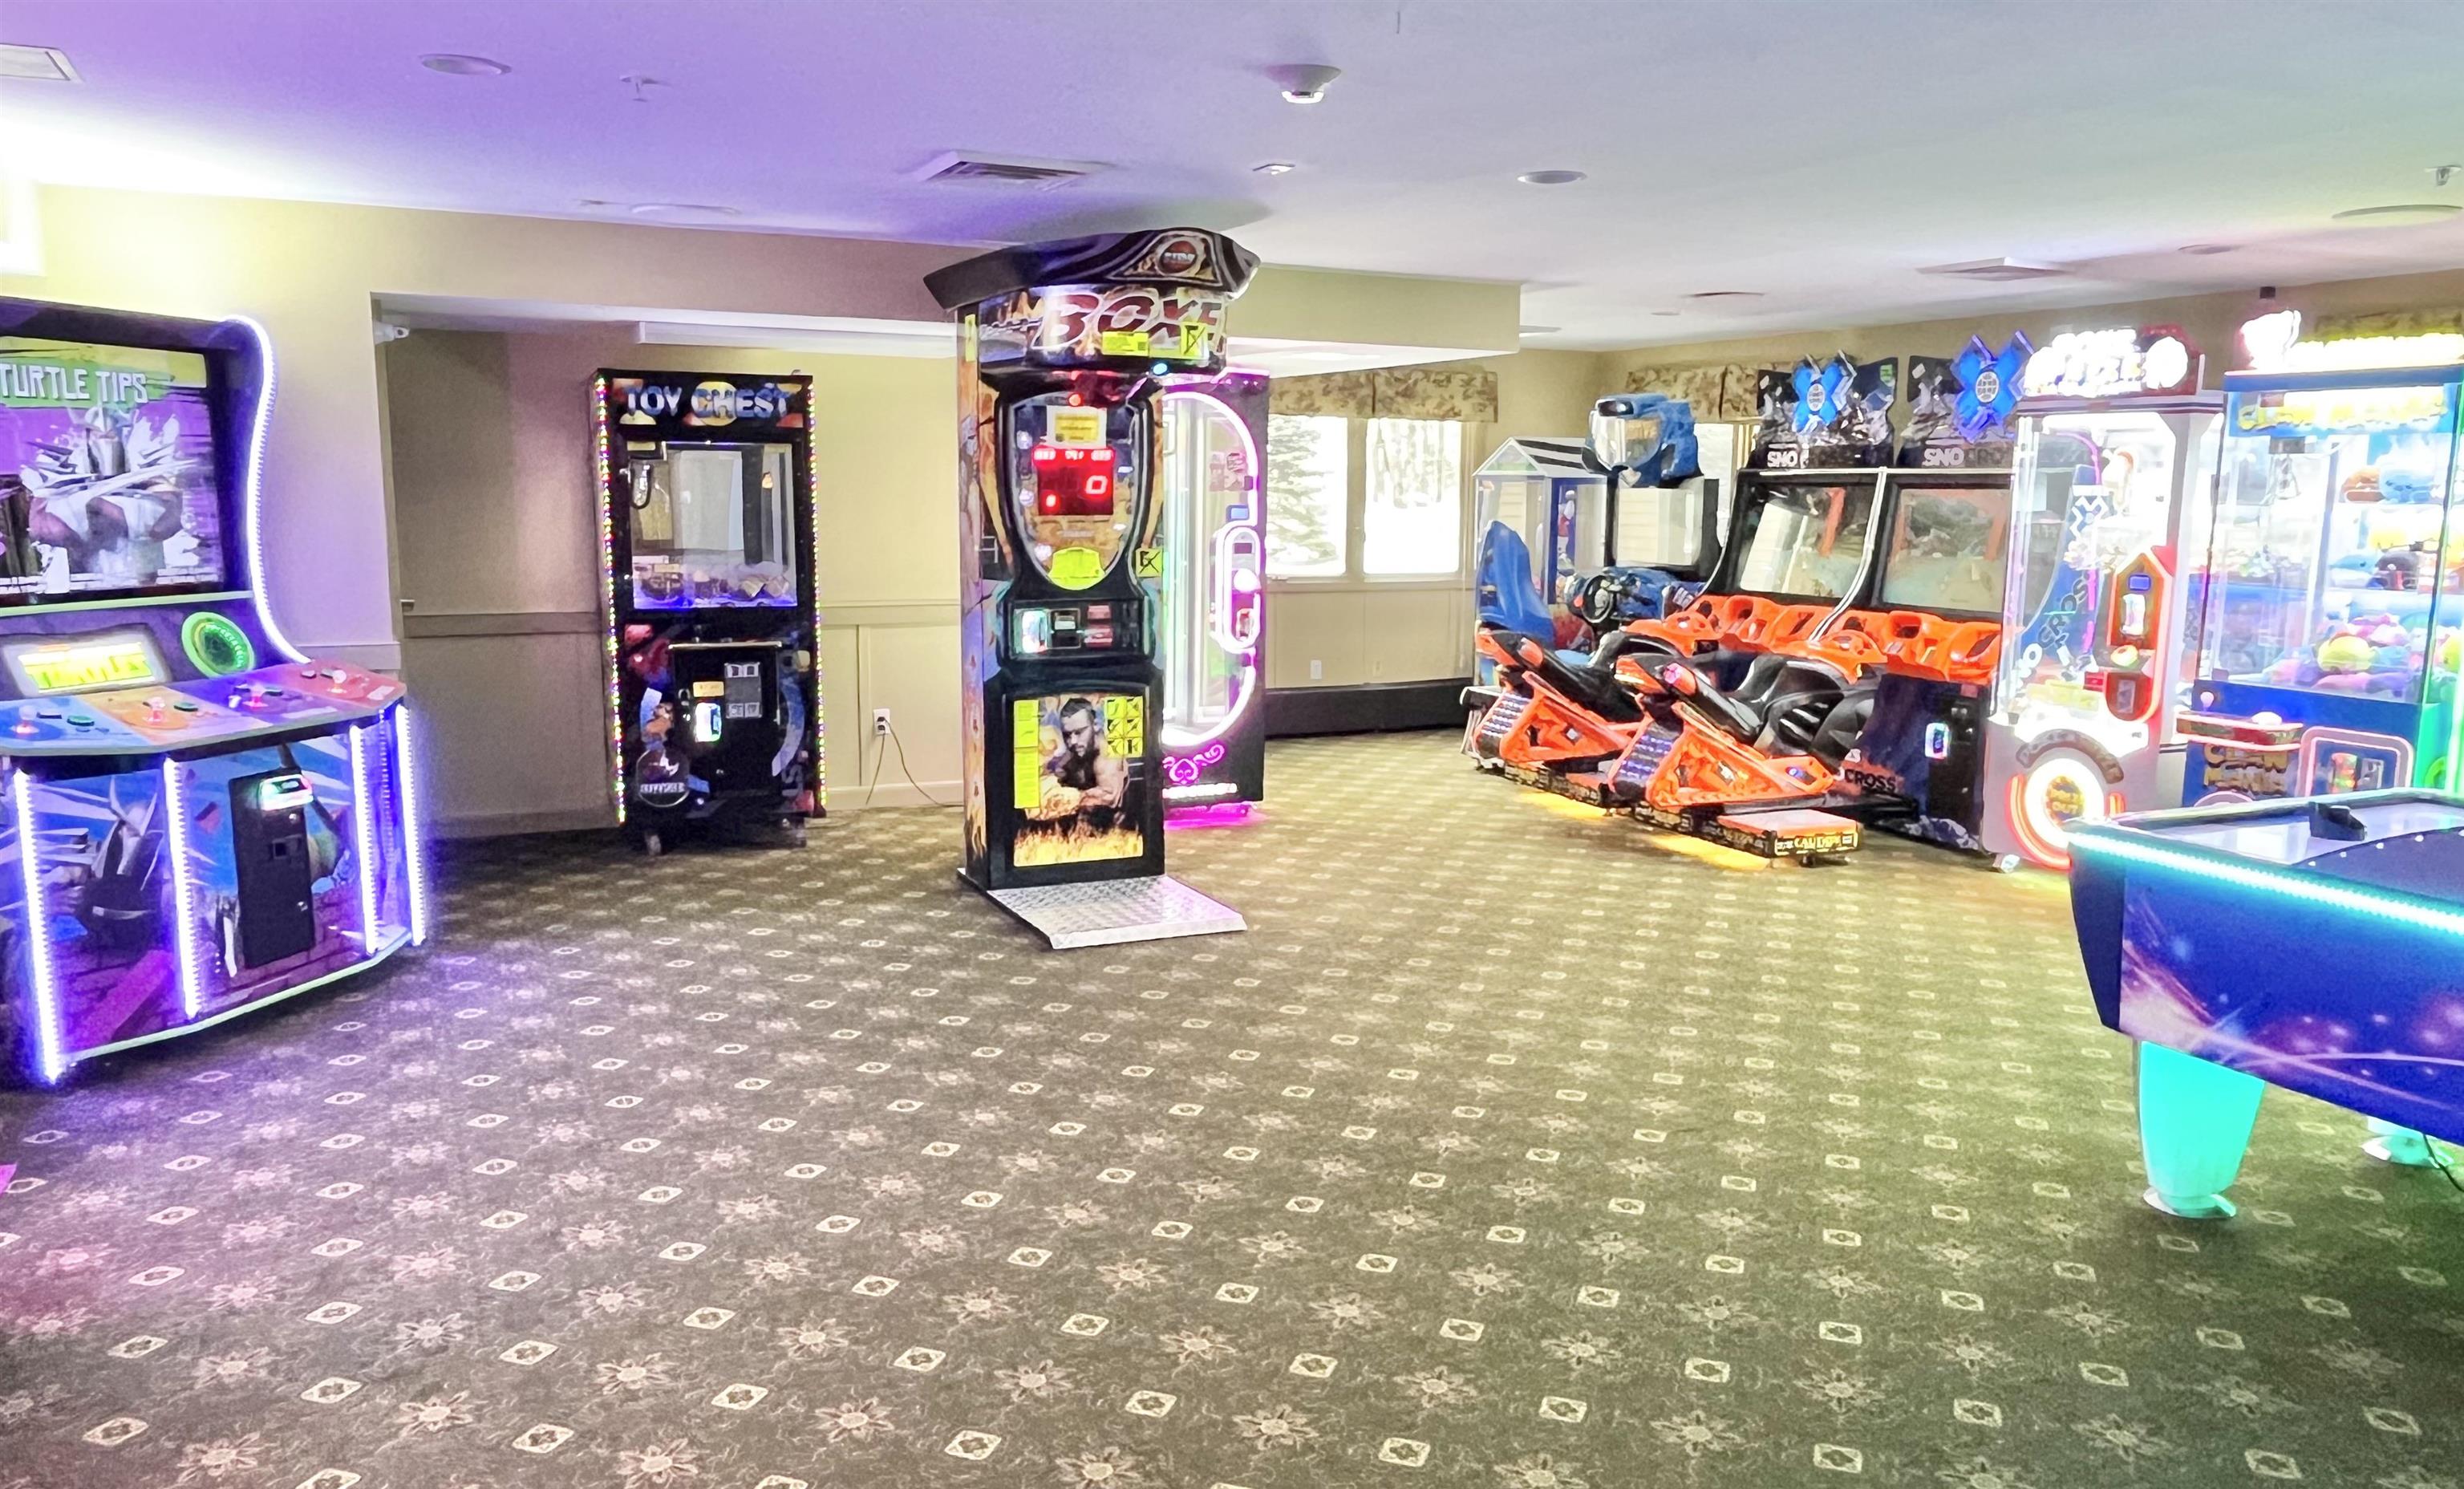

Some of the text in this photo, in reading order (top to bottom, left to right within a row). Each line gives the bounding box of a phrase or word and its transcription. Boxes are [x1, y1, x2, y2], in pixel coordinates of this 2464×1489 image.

[0, 363, 148, 404] TURTLE TIPS
[623, 383, 790, 419] TOY CHEST
[1922, 447, 1965, 467] SNO
[1844, 769, 1898, 793] CROSS
